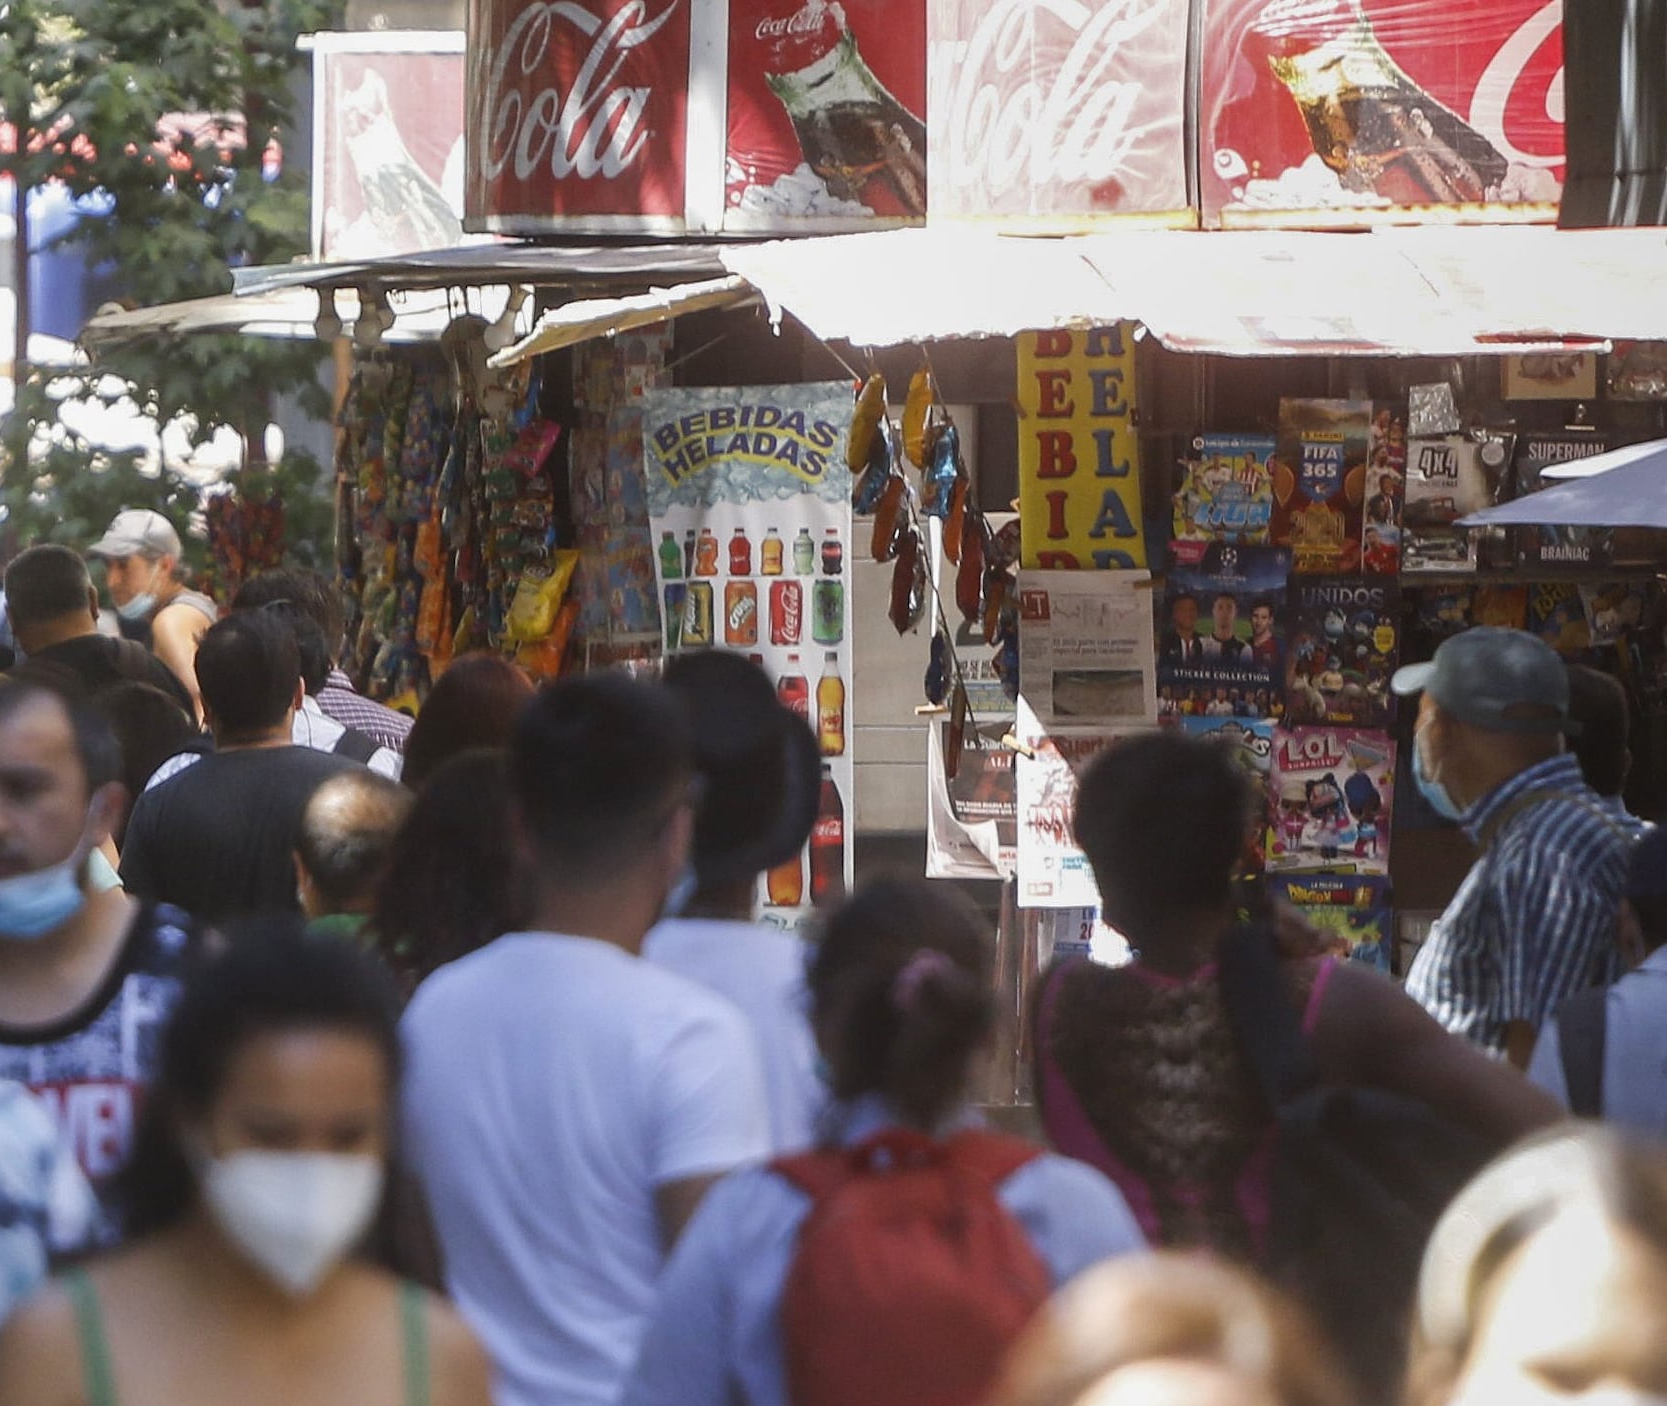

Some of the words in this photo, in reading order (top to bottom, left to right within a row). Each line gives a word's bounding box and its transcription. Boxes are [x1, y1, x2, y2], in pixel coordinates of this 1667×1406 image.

[654, 405, 838, 453] BEBIDAS
[663, 432, 827, 481] HELADAS
[1304, 447, 1337, 459] FIFA
[1303, 463, 1337, 478] 365
[1540, 547, 1590, 562] BRAINIAC
[1301, 586, 1385, 605] UNIDOS
[1173, 669, 1210, 680] STICKER
[1213, 670, 1270, 682] COLLECTION
[1286, 734, 1345, 760] LOL
